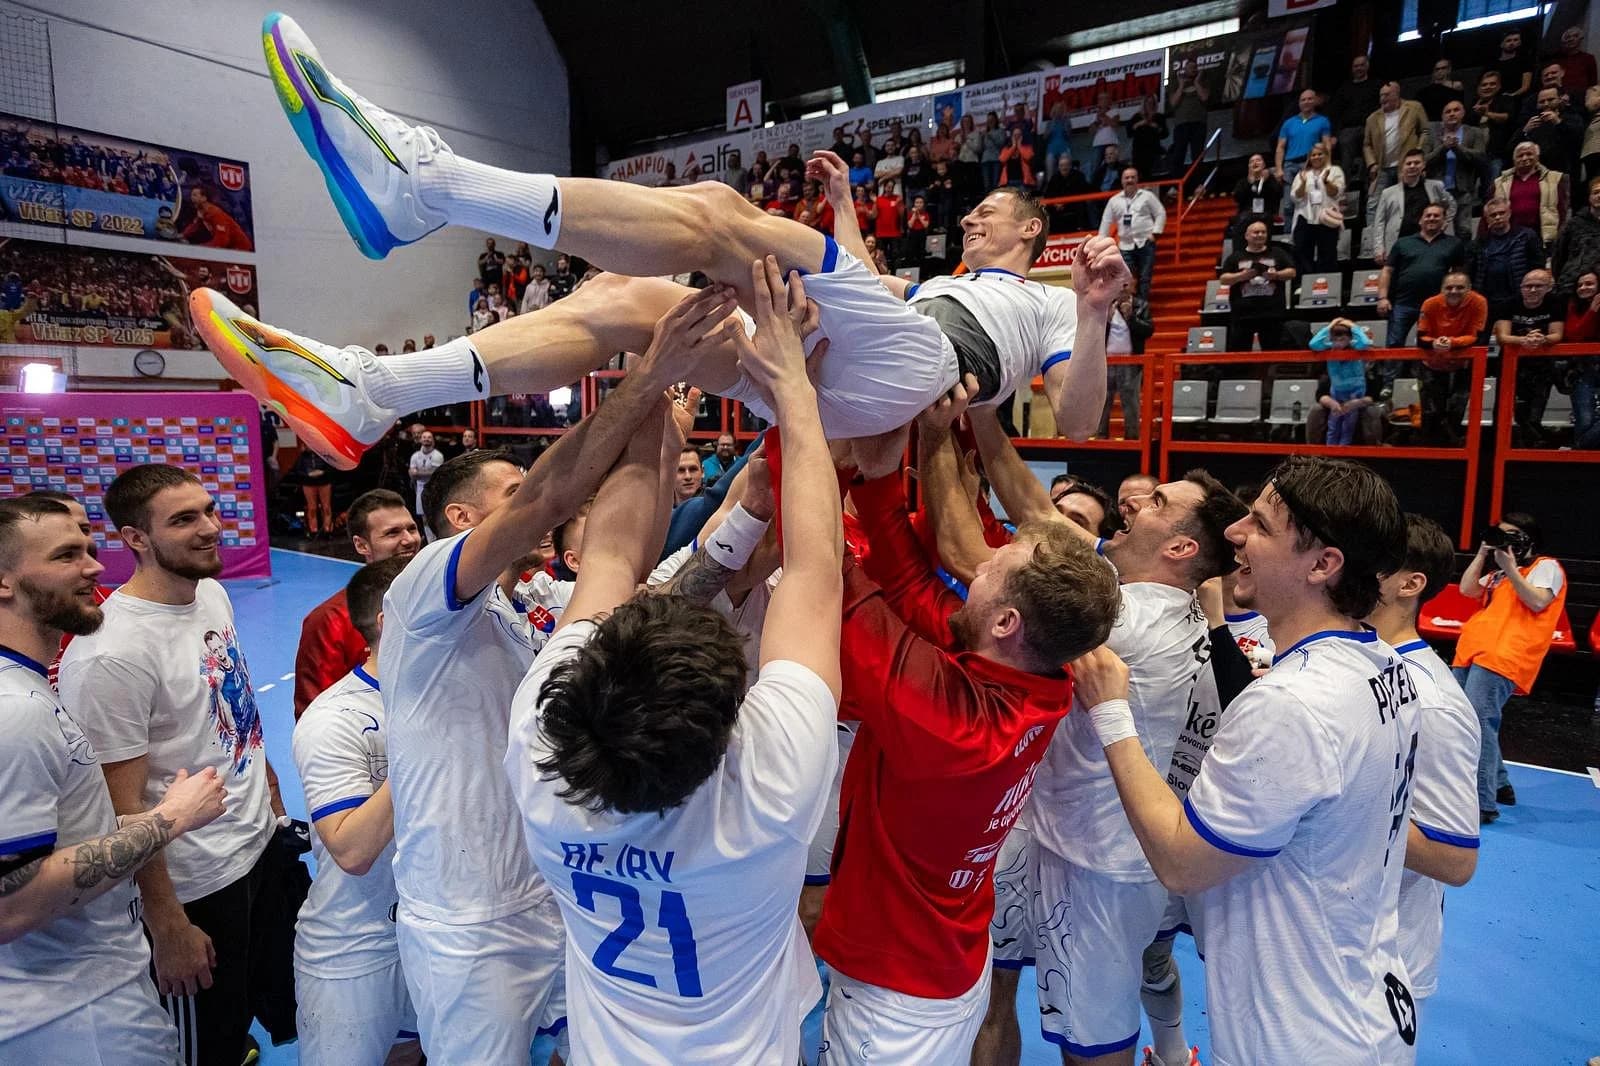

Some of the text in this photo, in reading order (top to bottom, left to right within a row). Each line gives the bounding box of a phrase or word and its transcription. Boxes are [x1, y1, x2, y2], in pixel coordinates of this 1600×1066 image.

[733, 98, 752, 127] A
[866, 113, 923, 130] SPEKTRUM
[610, 155, 668, 181] CHAMPIO
[102, 214, 145, 235] 2022
[571, 871, 703, 997] 21
